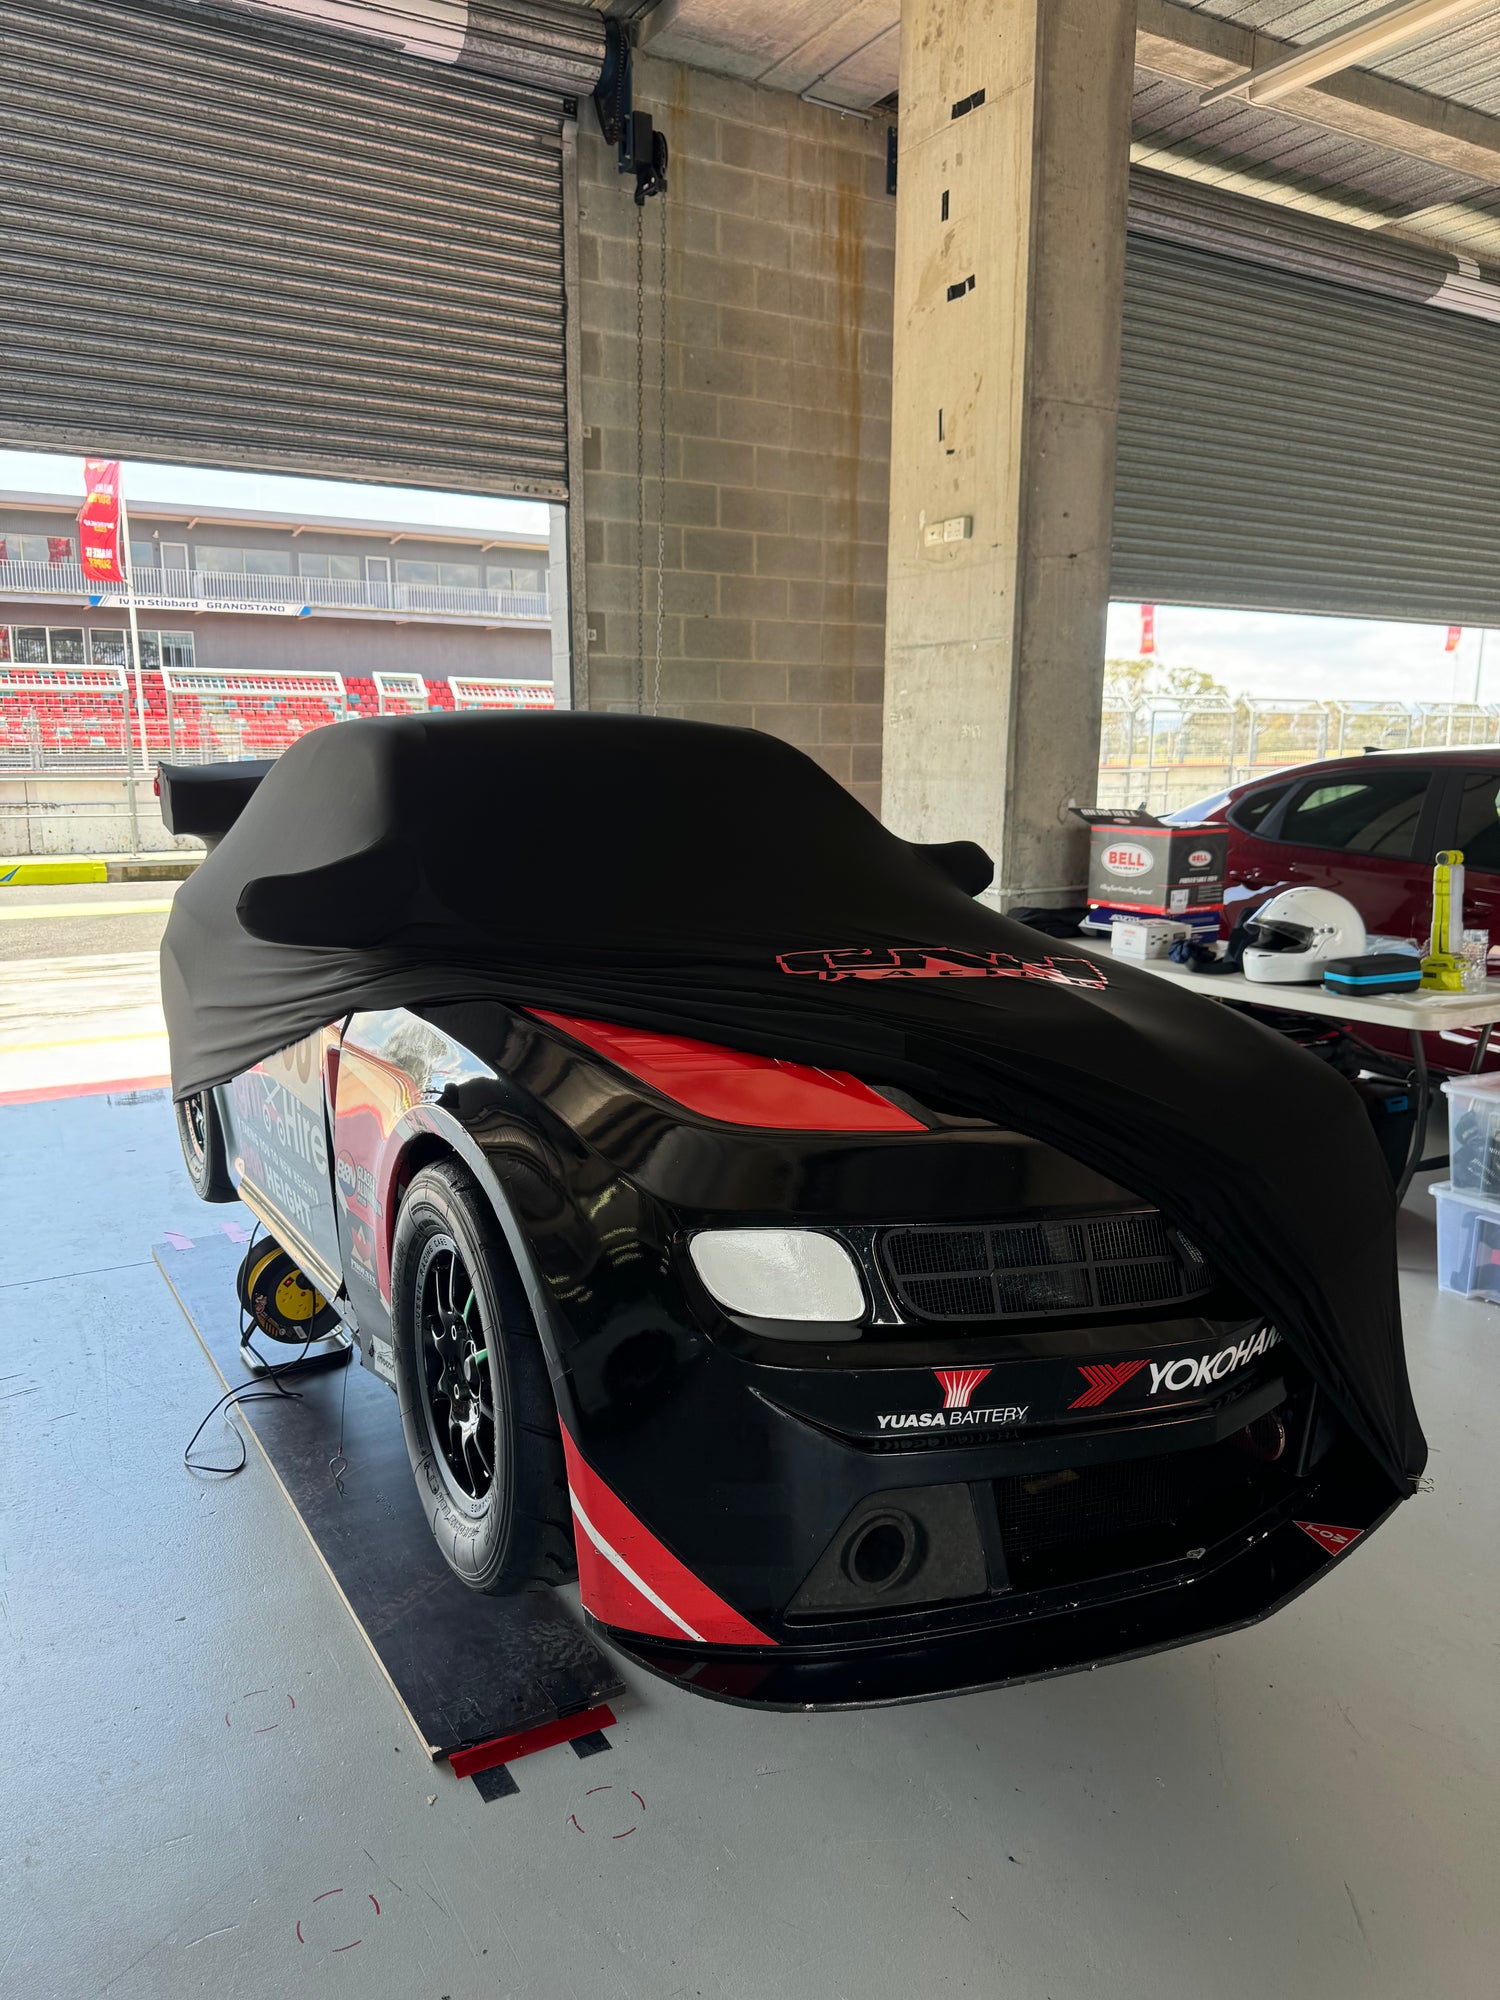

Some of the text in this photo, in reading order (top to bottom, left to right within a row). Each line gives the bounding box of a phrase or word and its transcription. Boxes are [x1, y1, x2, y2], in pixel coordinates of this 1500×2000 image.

[147, 598, 199, 608] Stibbard
[206, 601, 286, 612] GRANDSTAND
[1108, 851, 1146, 868] BELL
[1191, 854, 1209, 863] BELL
[282, 1087, 327, 1176] Hire
[264, 1161, 313, 1232] HEIGHT
[420, 1245, 434, 1277] RACING
[877, 1406, 1030, 1429] YUASA BATTERY
[1305, 1524, 1348, 1545] TOW
